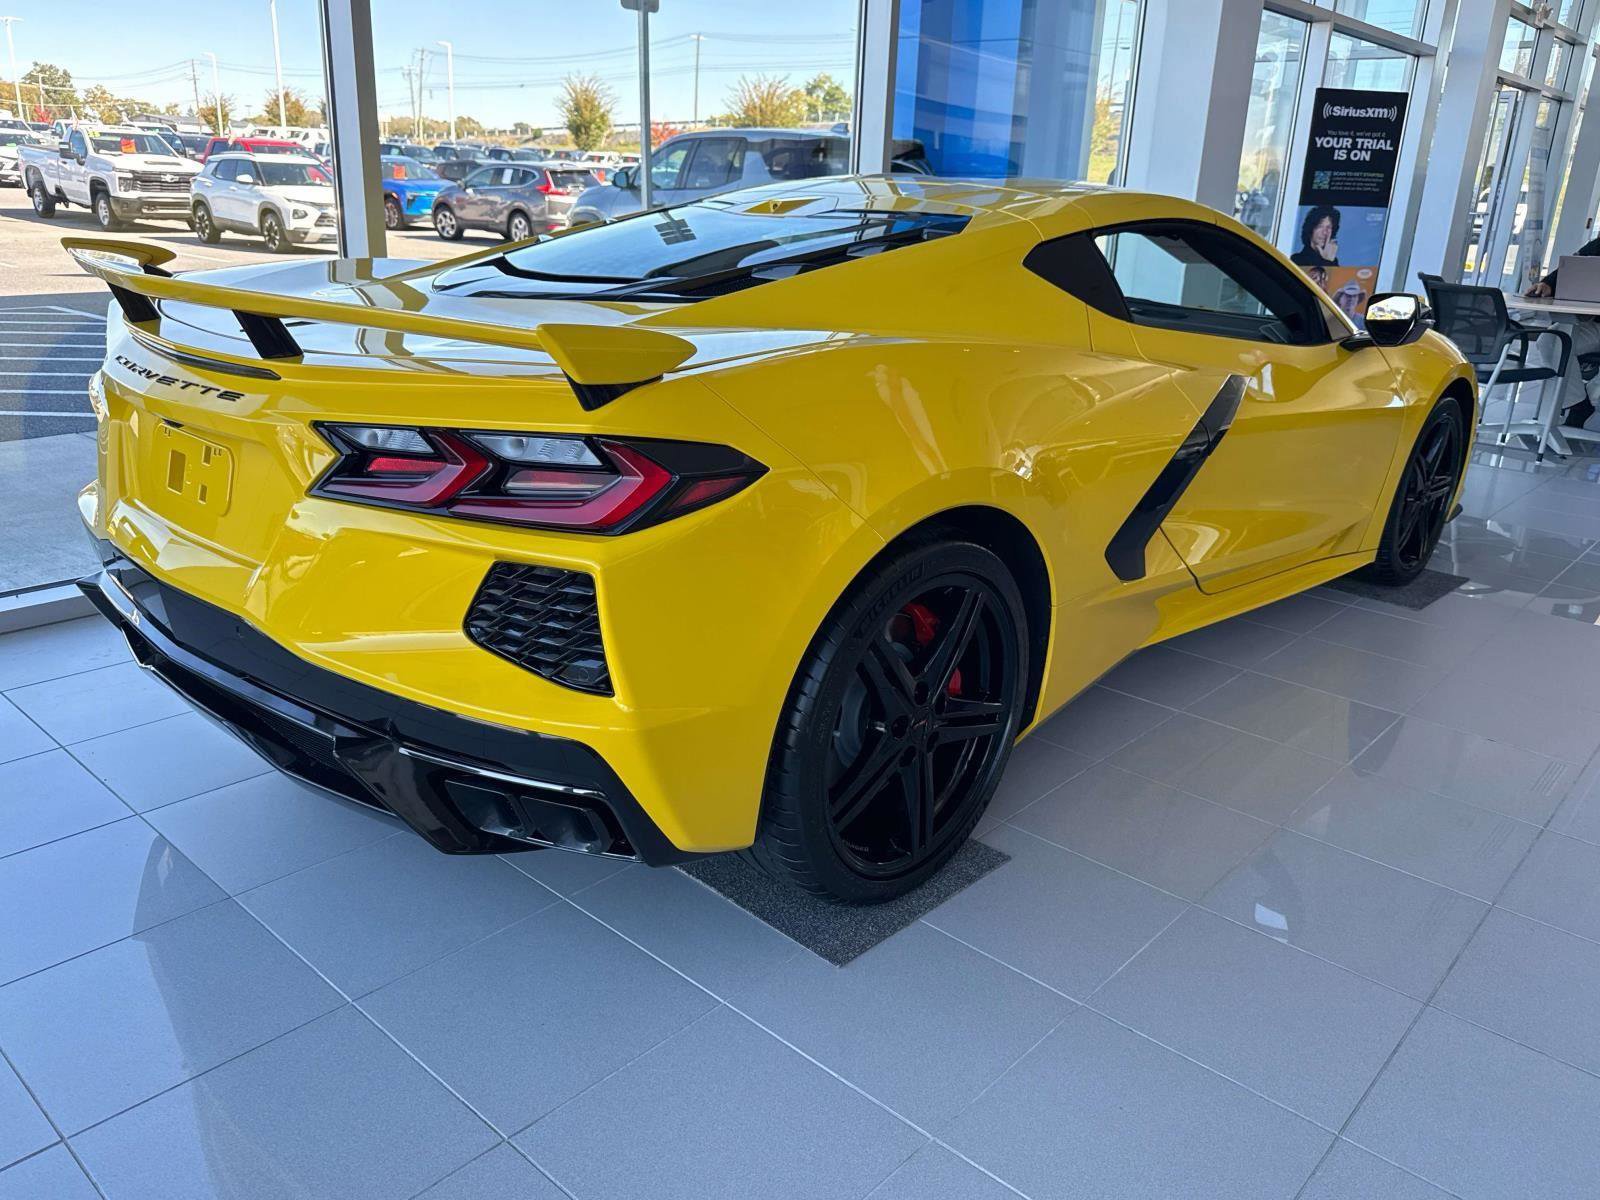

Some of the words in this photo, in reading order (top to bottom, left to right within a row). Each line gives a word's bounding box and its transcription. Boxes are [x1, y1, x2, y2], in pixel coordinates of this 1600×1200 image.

[1315, 137, 1352, 148] YOUR
[1356, 138, 1393, 150] TRIAL
[1333, 149, 1347, 160] IS
[1350, 150, 1371, 161] ON
[115, 355, 245, 402] CORVETTE
